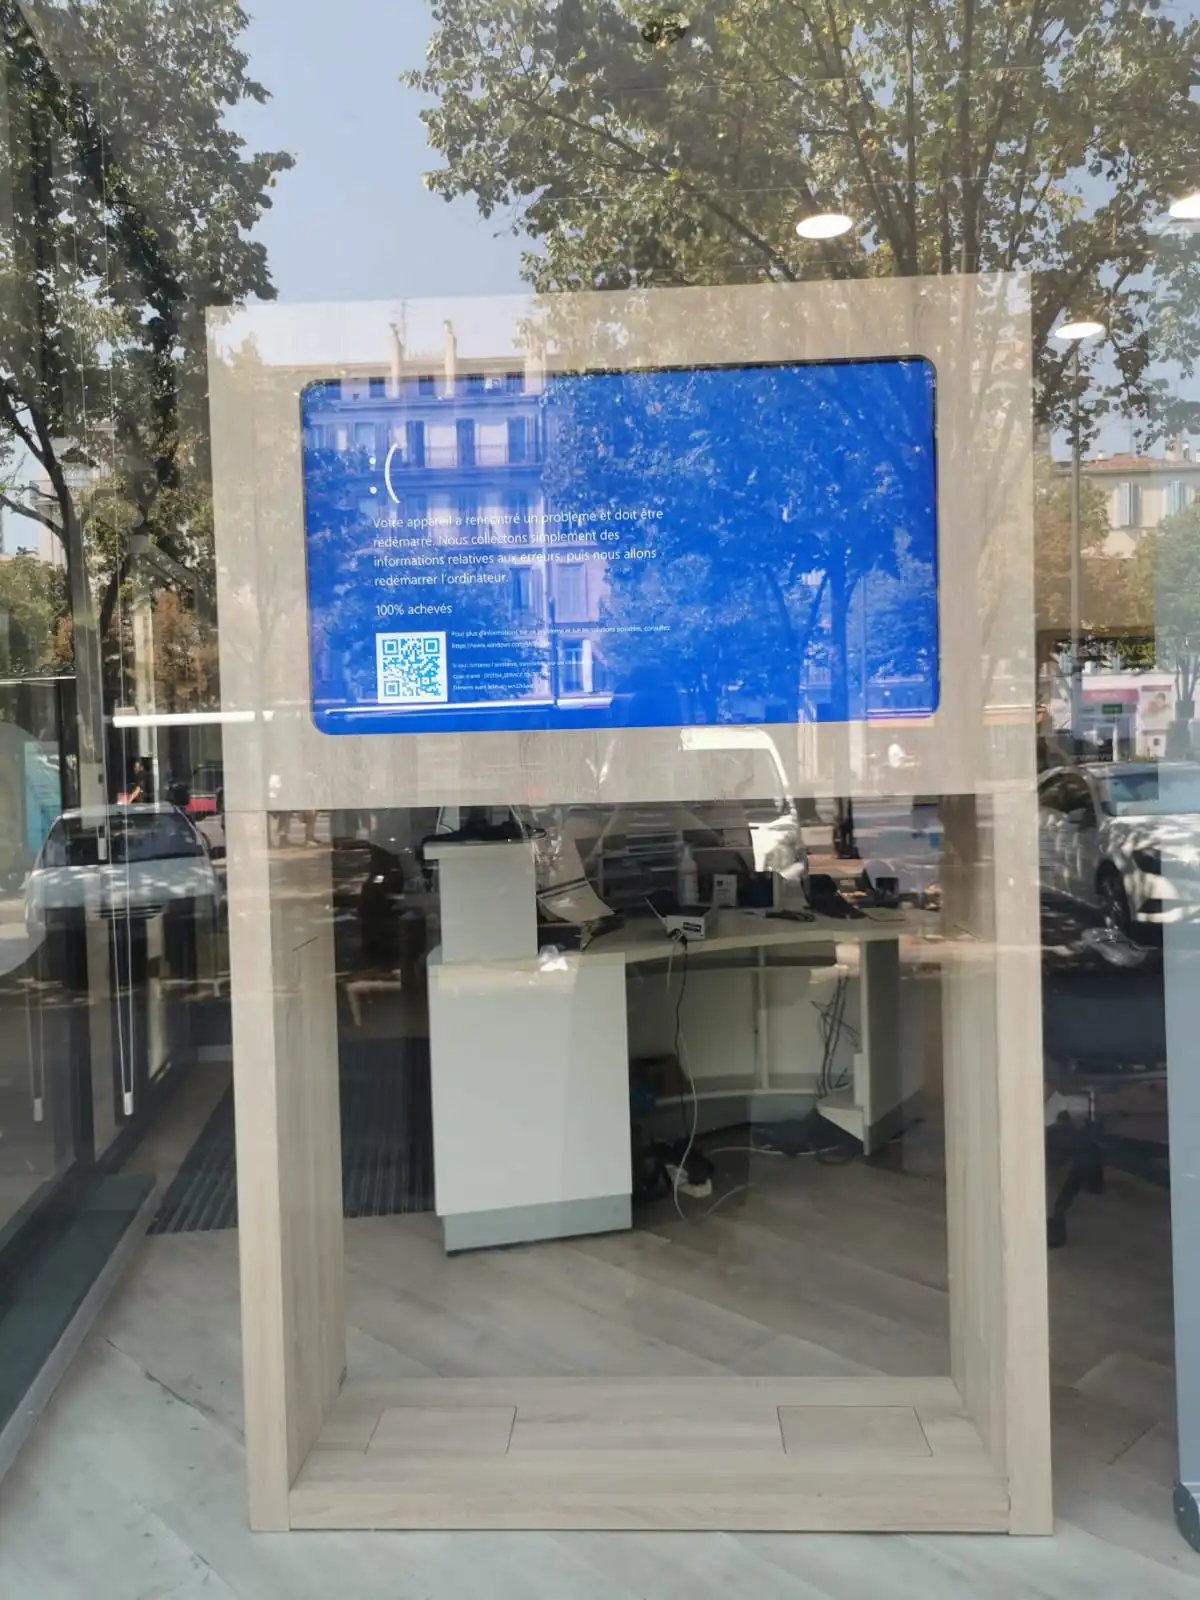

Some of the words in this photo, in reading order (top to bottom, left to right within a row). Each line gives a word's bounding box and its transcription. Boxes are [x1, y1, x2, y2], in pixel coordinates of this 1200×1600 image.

[373, 517, 403, 528] Votre
[407, 515, 452, 529] appareil
[455, 517, 462, 526] a
[466, 513, 520, 526] rencontré
[524, 514, 538, 523] un
[542, 510, 597, 524] problème
[600, 511, 611, 521] et
[615, 508, 637, 520] doit
[640, 507, 664, 520] être
[438, 535, 468, 545] Nous
[471, 531, 527, 545] collectons
[530, 530, 596, 544] simplement
[600, 529, 620, 541] des
[374, 554, 445, 567] informations
[448, 553, 494, 565] relatives
[497, 555, 519, 565] aux
[567, 550, 590, 563] puis
[593, 550, 620, 561] nous
[624, 548, 657, 560] allons
[374, 573, 437, 586] redémarrer
[441, 571, 509, 585] l'ordinateur.
[376, 604, 405, 616] 100%
[408, 602, 453, 615] achevés
